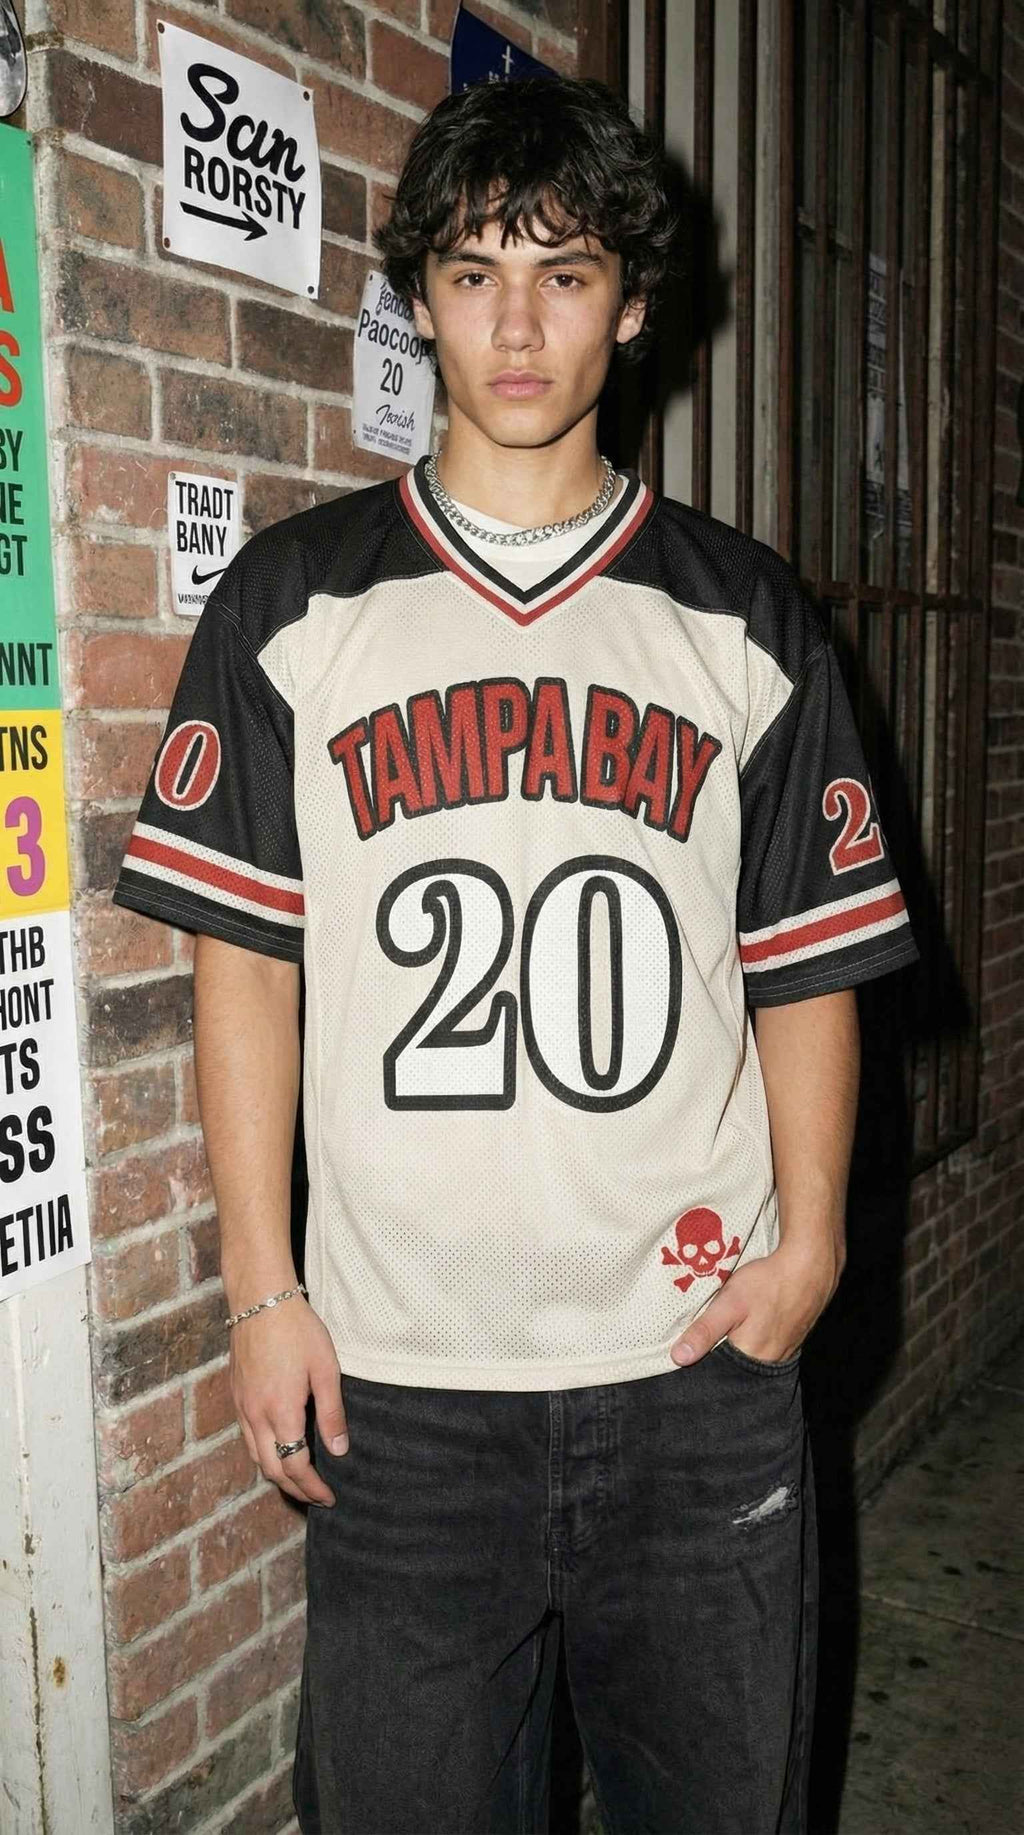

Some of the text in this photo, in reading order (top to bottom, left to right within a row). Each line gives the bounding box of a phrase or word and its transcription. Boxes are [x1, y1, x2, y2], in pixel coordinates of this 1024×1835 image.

[180, 63, 305, 182] San
[184, 145, 306, 229] RORSTY
[380, 358, 403, 396] 20
[175, 480, 234, 520] TRADT
[176, 520, 227, 557] BANY
[154, 719, 221, 811] 0
[327, 677, 722, 843] TAMPA BAY
[5, 796, 46, 897] 3
[822, 777, 885, 876] 2
[375, 854, 683, 1113] 20
[0, 1105, 55, 1184] SS
